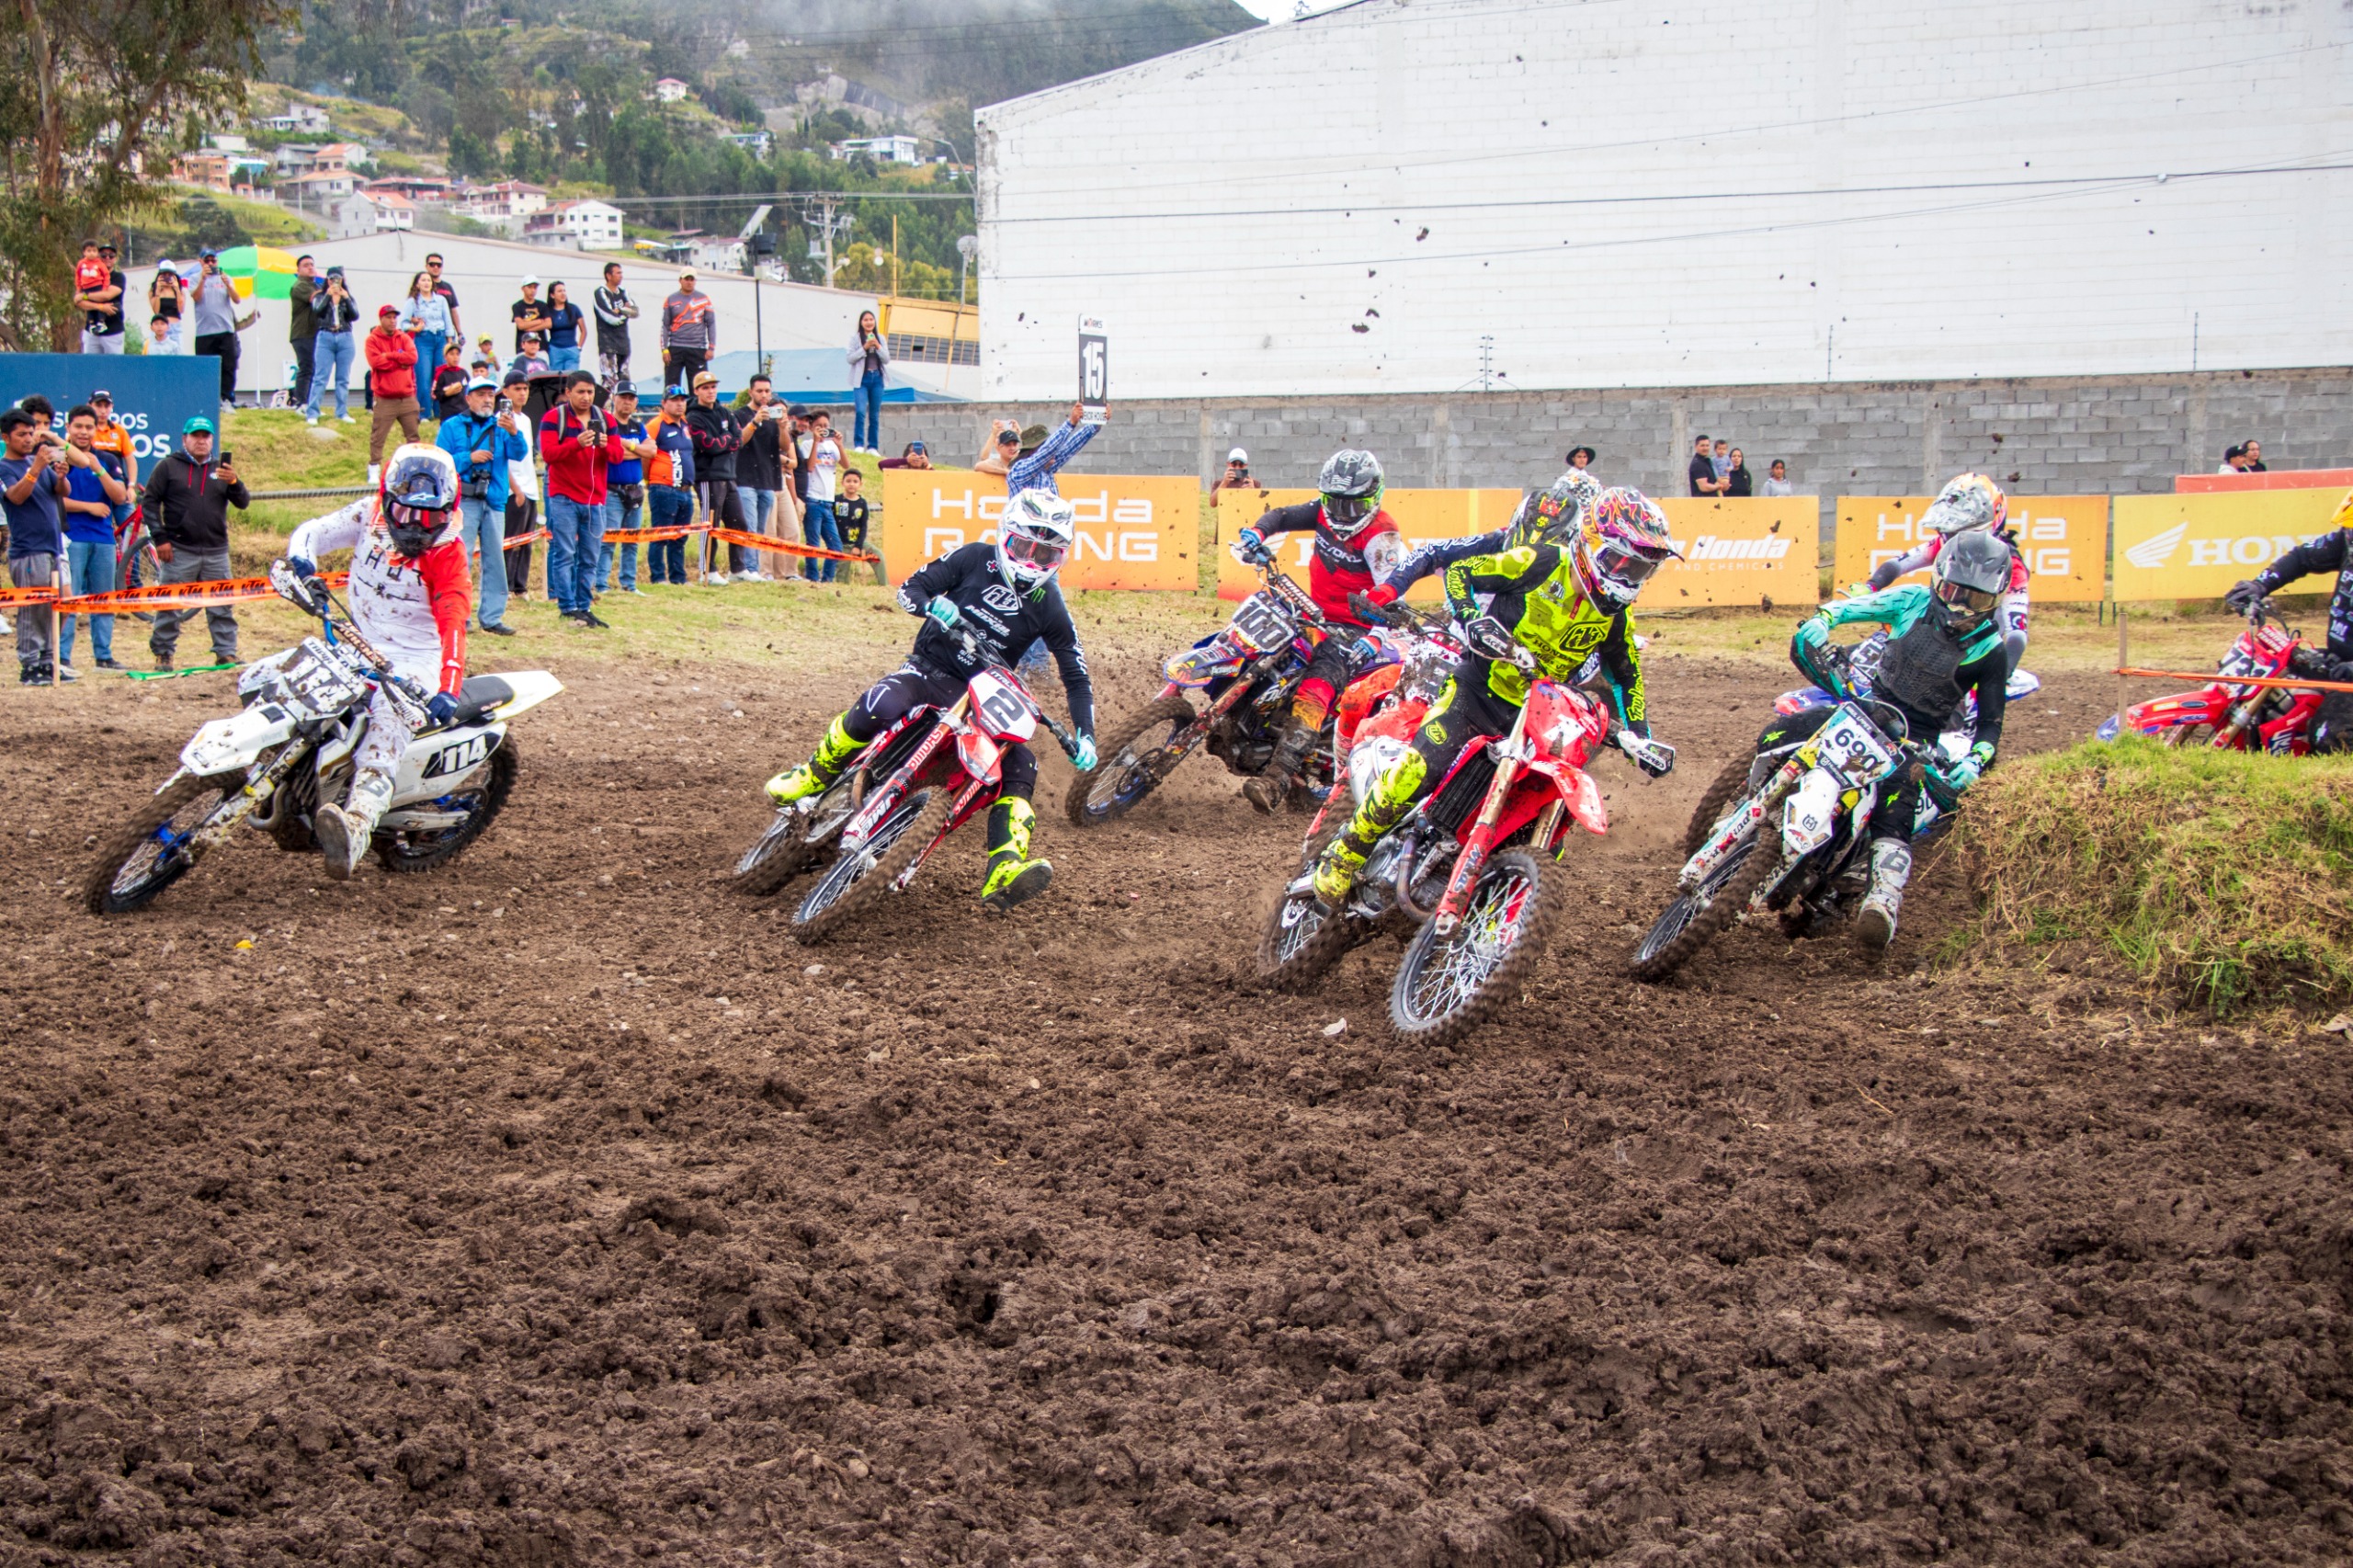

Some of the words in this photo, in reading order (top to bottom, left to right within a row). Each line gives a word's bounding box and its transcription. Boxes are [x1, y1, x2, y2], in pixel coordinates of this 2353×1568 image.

[1083, 341, 1104, 400] 15
[932, 488, 1153, 523] Hoda
[1688, 535, 1791, 560] Honda
[1675, 562, 1700, 572] AND
[116, 590, 141, 601] KTM
[147, 587, 172, 597] KTM
[178, 585, 203, 598] KTM
[210, 583, 234, 597] KTM
[242, 580, 266, 595] KTM
[1233, 600, 1288, 651] 100
[991, 670, 1017, 691] ITALO
[981, 687, 1025, 731] 2
[1542, 713, 1586, 747] 1
[443, 734, 488, 774] 114
[1835, 728, 1878, 773] 690
